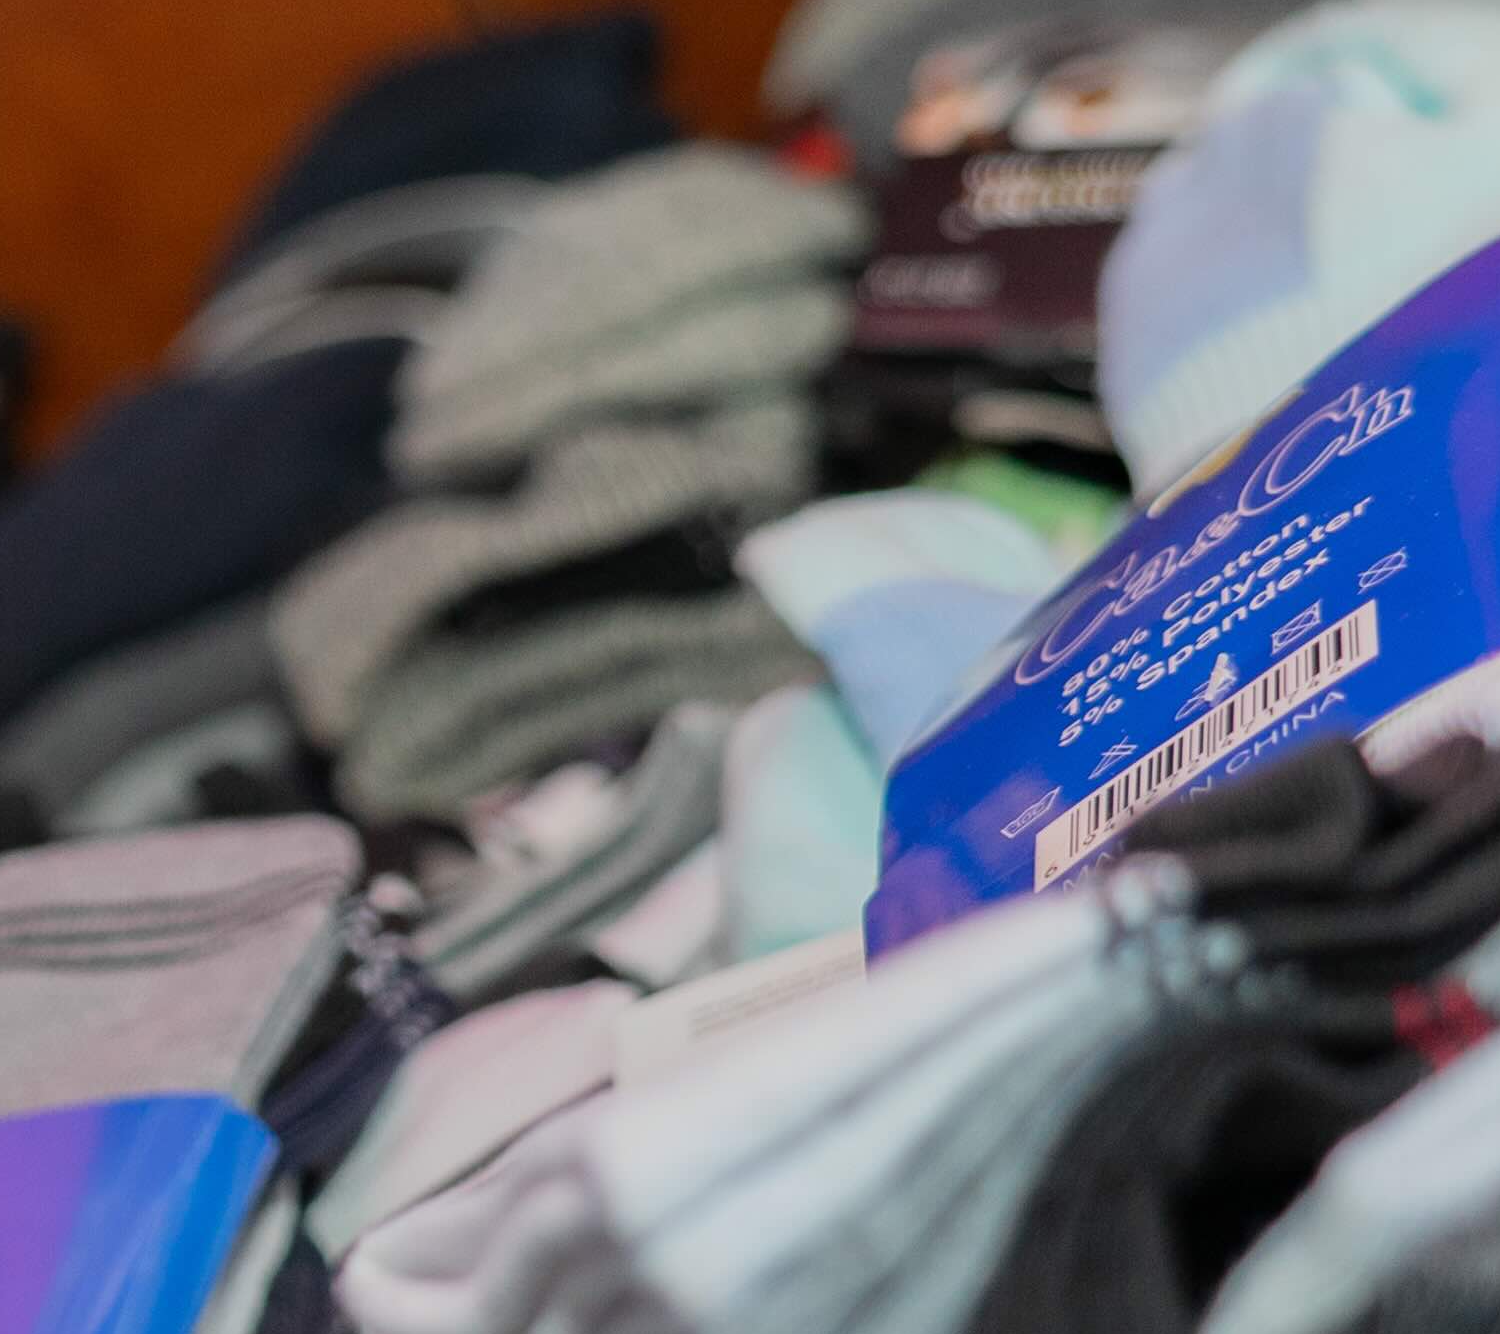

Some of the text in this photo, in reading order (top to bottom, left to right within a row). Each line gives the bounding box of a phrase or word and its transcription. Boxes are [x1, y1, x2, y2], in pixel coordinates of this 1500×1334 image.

[1058, 547, 1331, 747] 5% Spandex
[1060, 495, 1374, 716] 15% Polyester
[1061, 514, 1311, 697] 80% Cotton
[1225, 690, 1346, 774] CHINA
